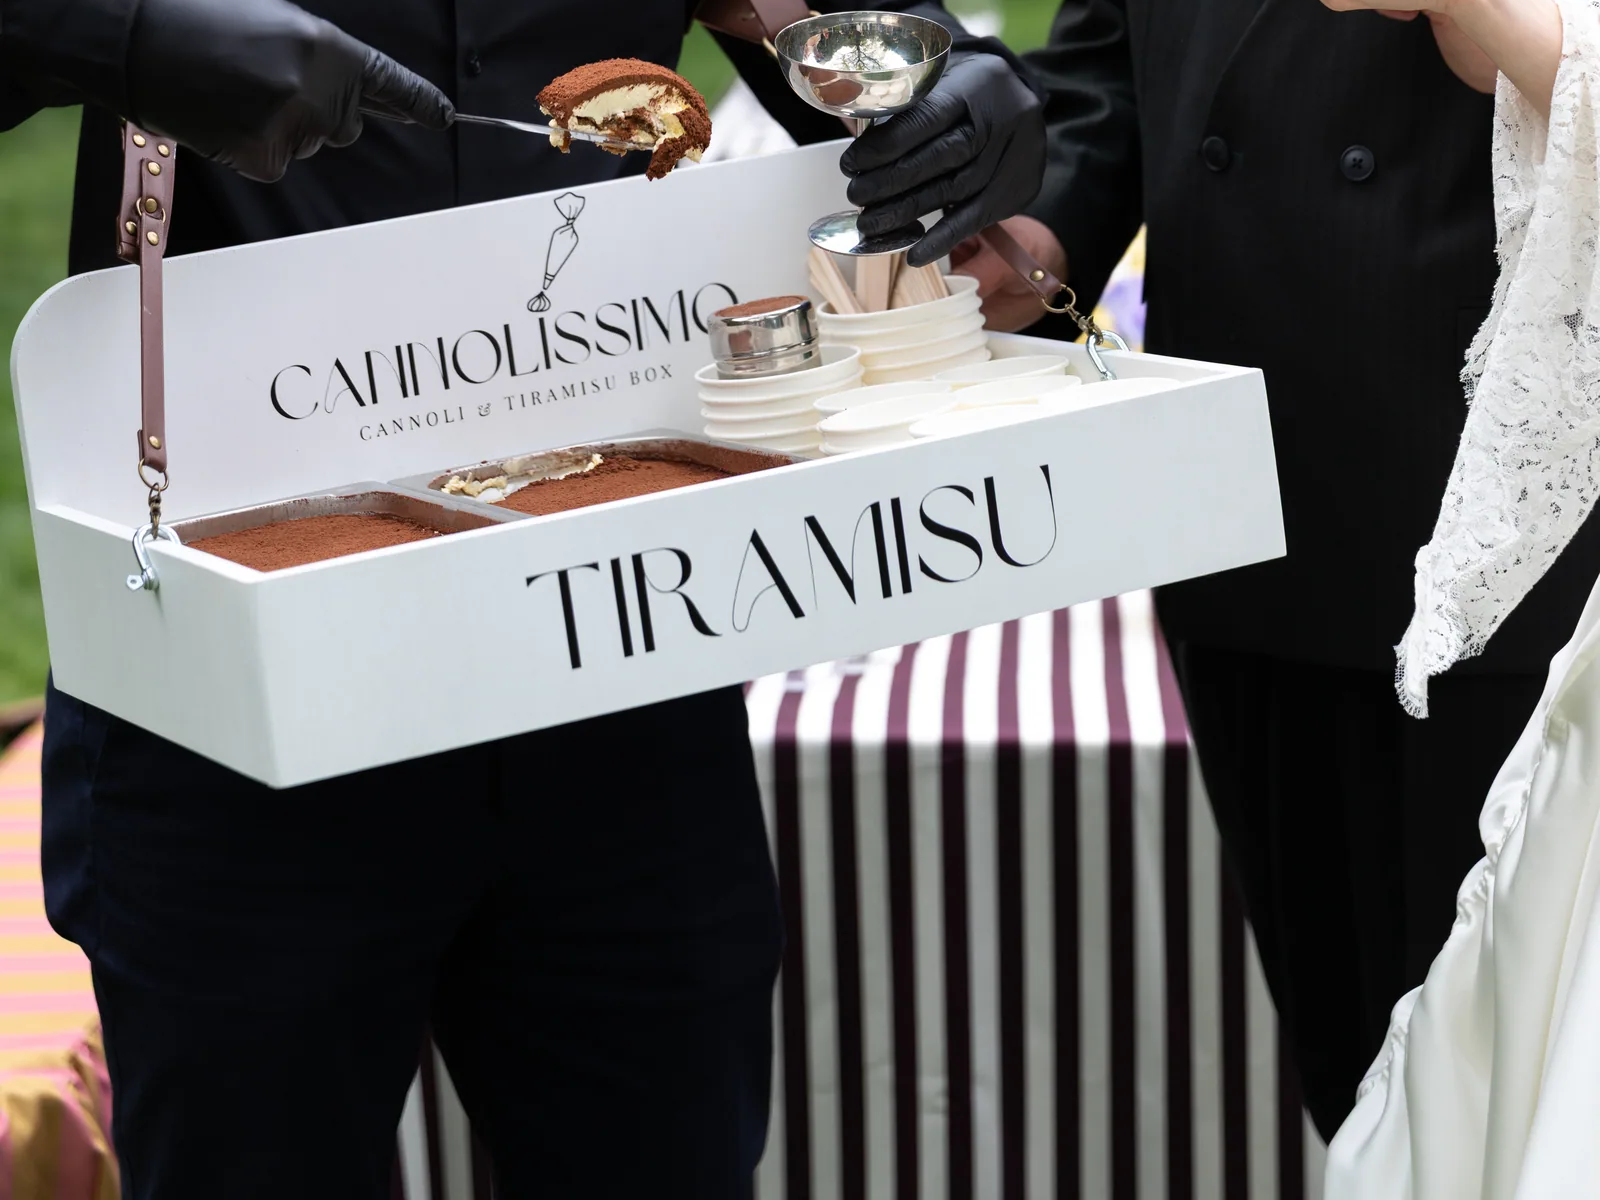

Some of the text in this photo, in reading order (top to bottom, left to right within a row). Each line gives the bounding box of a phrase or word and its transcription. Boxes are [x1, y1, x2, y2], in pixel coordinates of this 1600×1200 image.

[359, 363, 673, 441] CANNOLI & TIRAMISU BOX
[526, 464, 1057, 669] TIRAMISU
